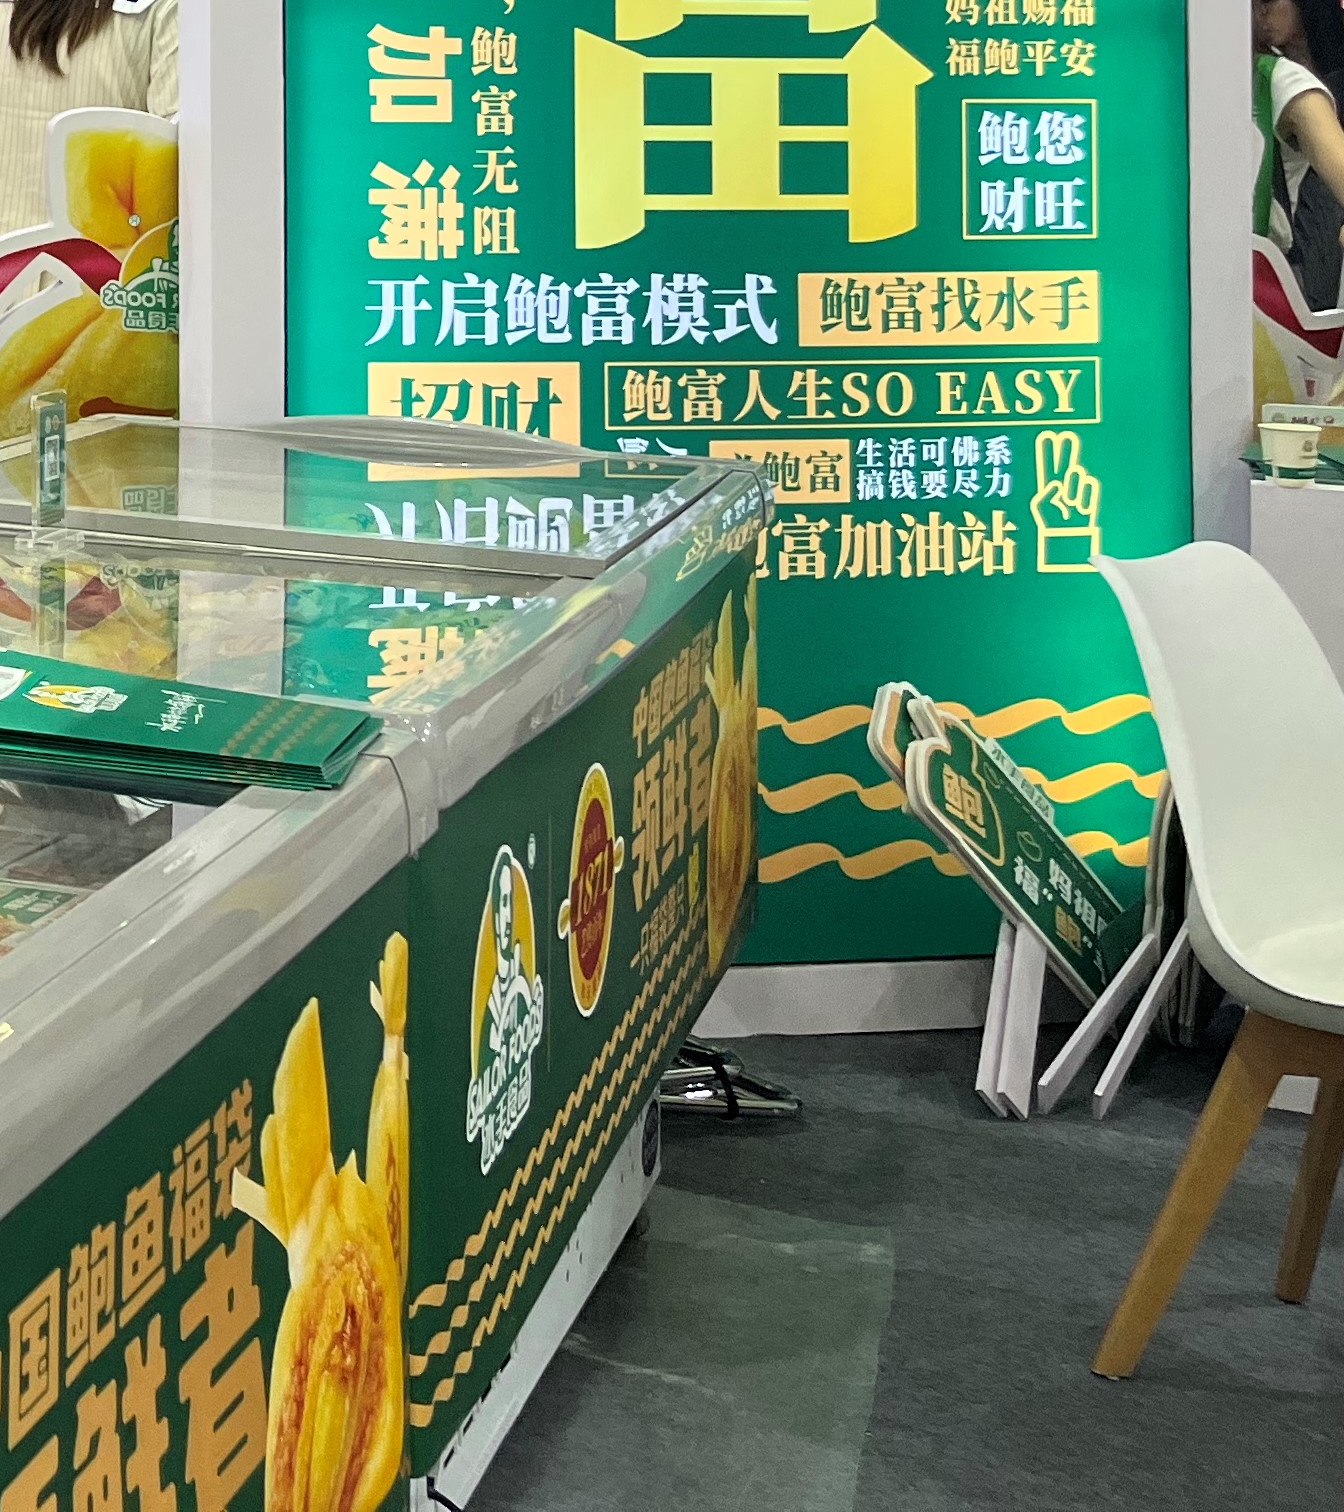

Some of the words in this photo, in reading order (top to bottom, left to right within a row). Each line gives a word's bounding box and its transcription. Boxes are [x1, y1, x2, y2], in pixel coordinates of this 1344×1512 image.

[944, 39, 1096, 79] 福鲍平安
[976, 109, 1087, 167] 鲍您
[977, 179, 1087, 234] 财旺
[365, 271, 779, 348] 开启鲍富模式
[818, 275, 1091, 335] 鲍富找水手
[855, 435, 1012, 469] 生活可佛系
[855, 467, 1012, 501] 搞钱要尽力
